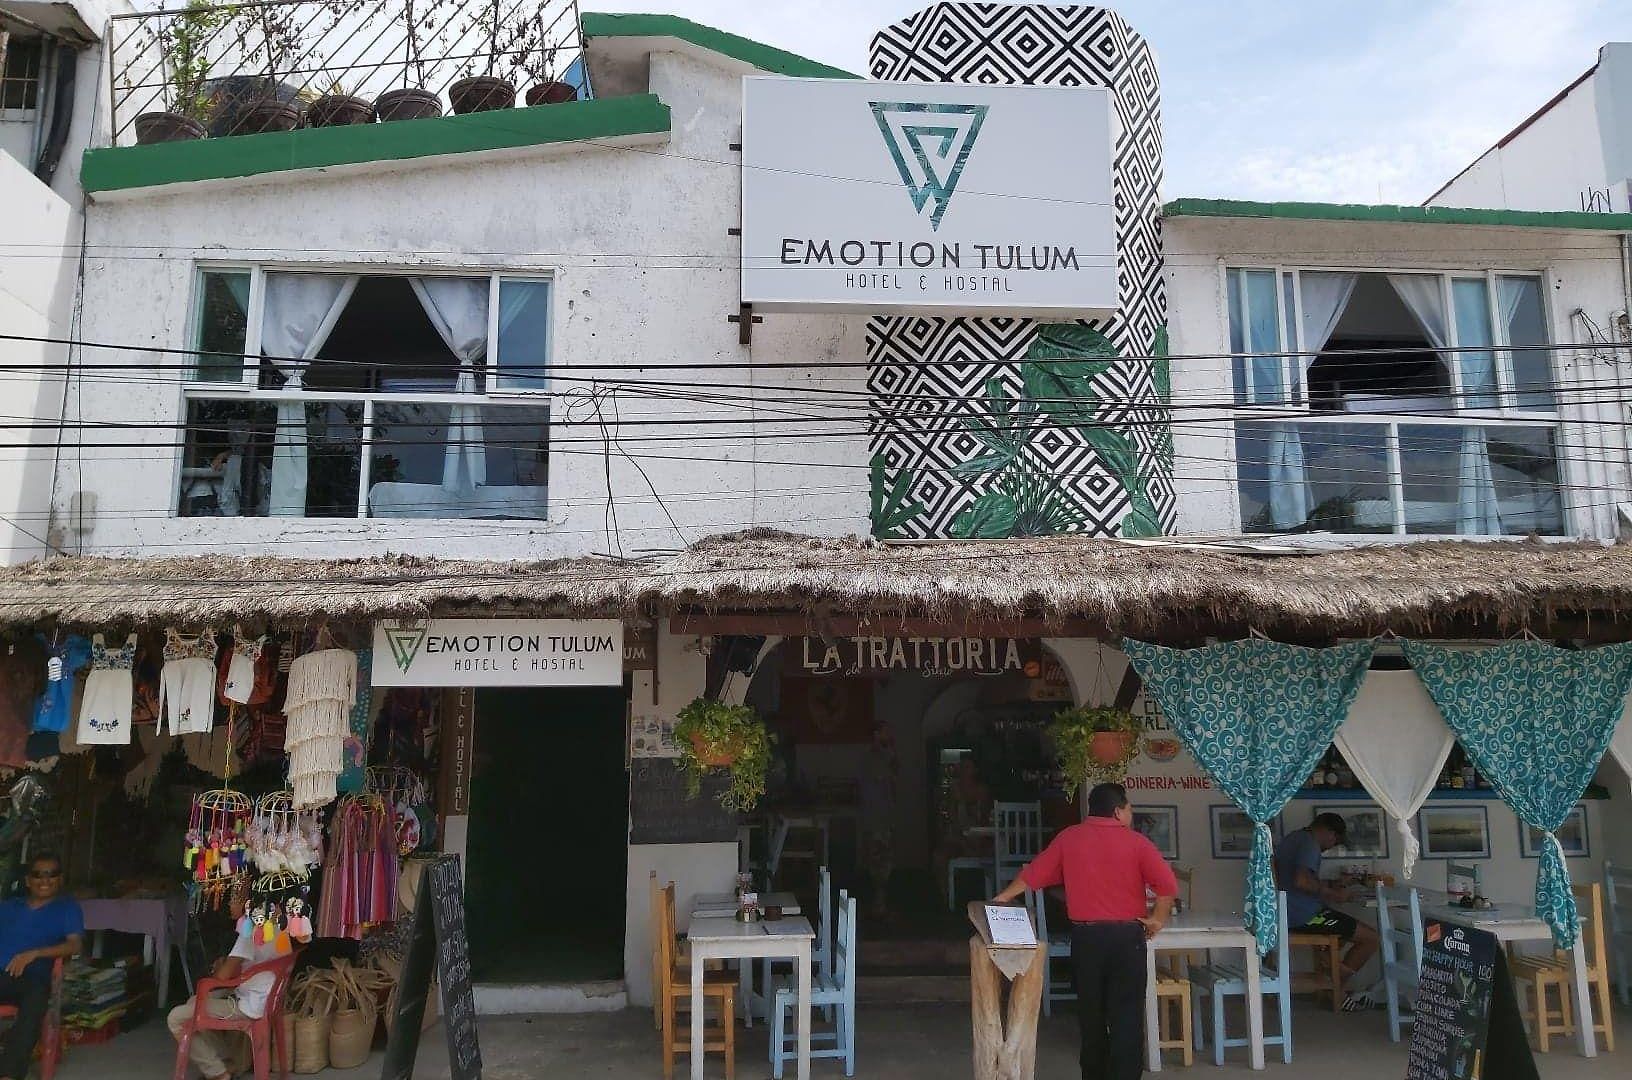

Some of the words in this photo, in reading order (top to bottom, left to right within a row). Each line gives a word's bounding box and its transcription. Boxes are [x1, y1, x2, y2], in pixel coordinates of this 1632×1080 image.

[780, 238, 960, 269] EMOTION
[974, 243, 1080, 271] TULUM
[846, 273, 902, 289] HOTEL
[944, 275, 1013, 292] HOSTAL
[426, 635, 540, 653] EMOTION
[548, 635, 614, 653] TULUM
[803, 637, 842, 668] LA
[850, 637, 1022, 669] TRATTORIA
[454, 658, 500, 671] HOTEL
[531, 658, 585, 671] HOSTAL
[455, 735, 465, 812] HOSTAL
[1443, 935, 1471, 953] Corona
[1454, 957, 1474, 977] HOUR
